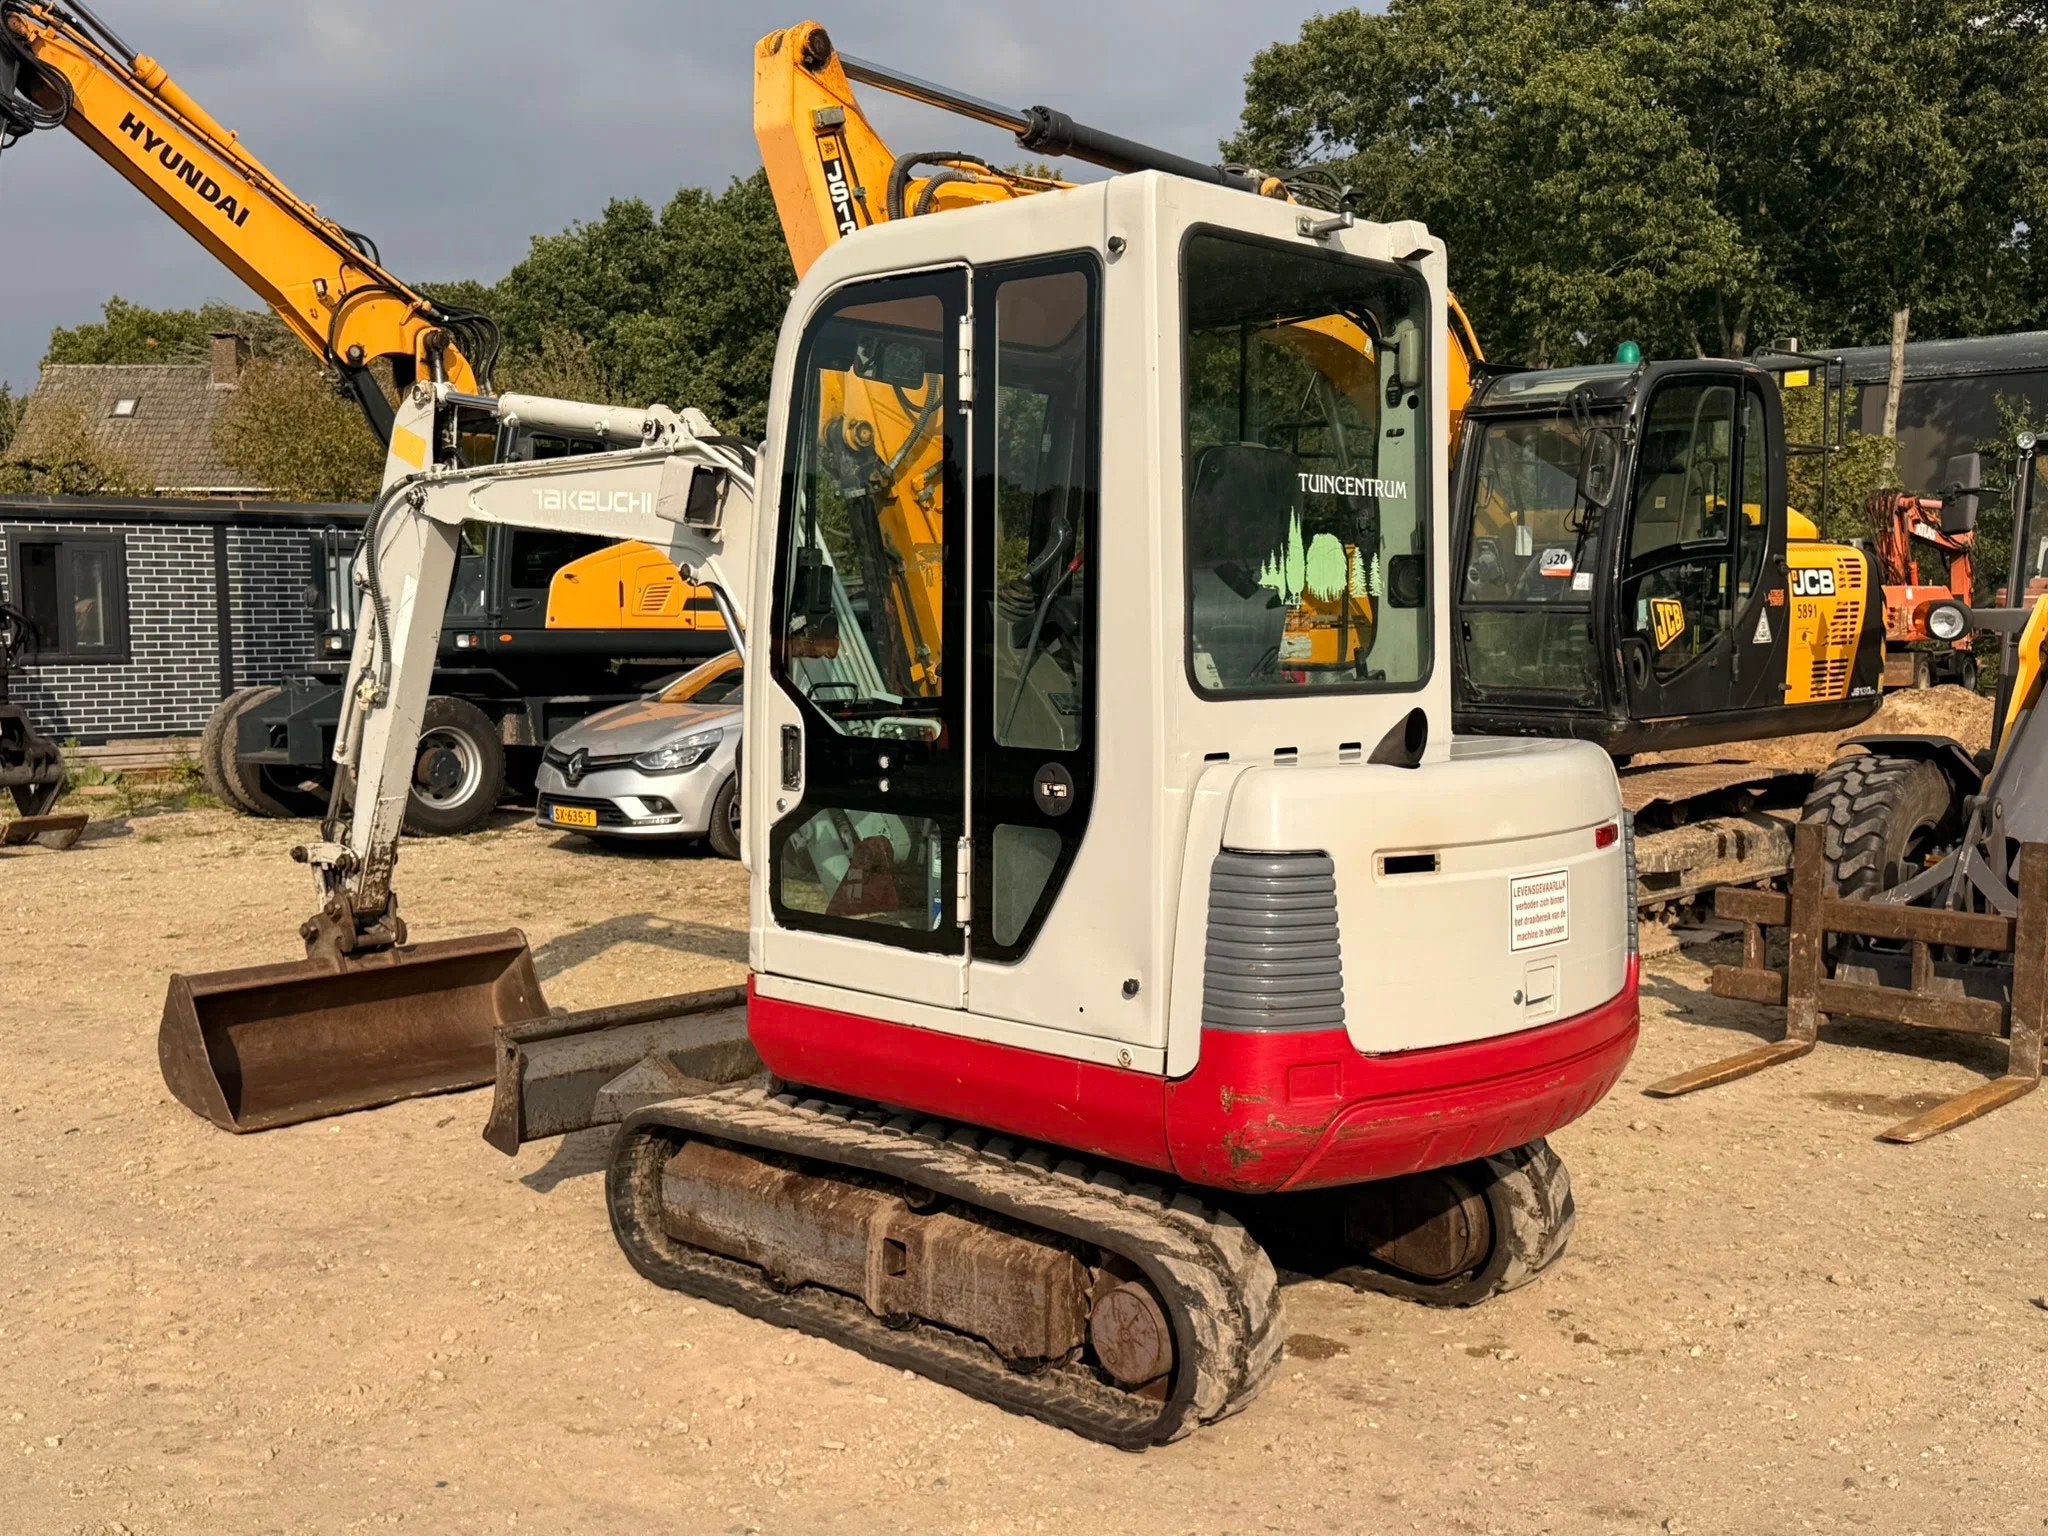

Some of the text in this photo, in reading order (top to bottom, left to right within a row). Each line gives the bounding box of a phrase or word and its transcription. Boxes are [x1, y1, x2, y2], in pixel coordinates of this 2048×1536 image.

[118, 111, 251, 227] HYUNDAI
[1298, 473, 1407, 499] TUINCENTRUM
[1793, 568, 1835, 596] JCB
[1655, 602, 1682, 643] JCB
[1797, 604, 1818, 619] 5891
[1515, 899, 1539, 911] verboden
[1516, 929, 1538, 942] machine
